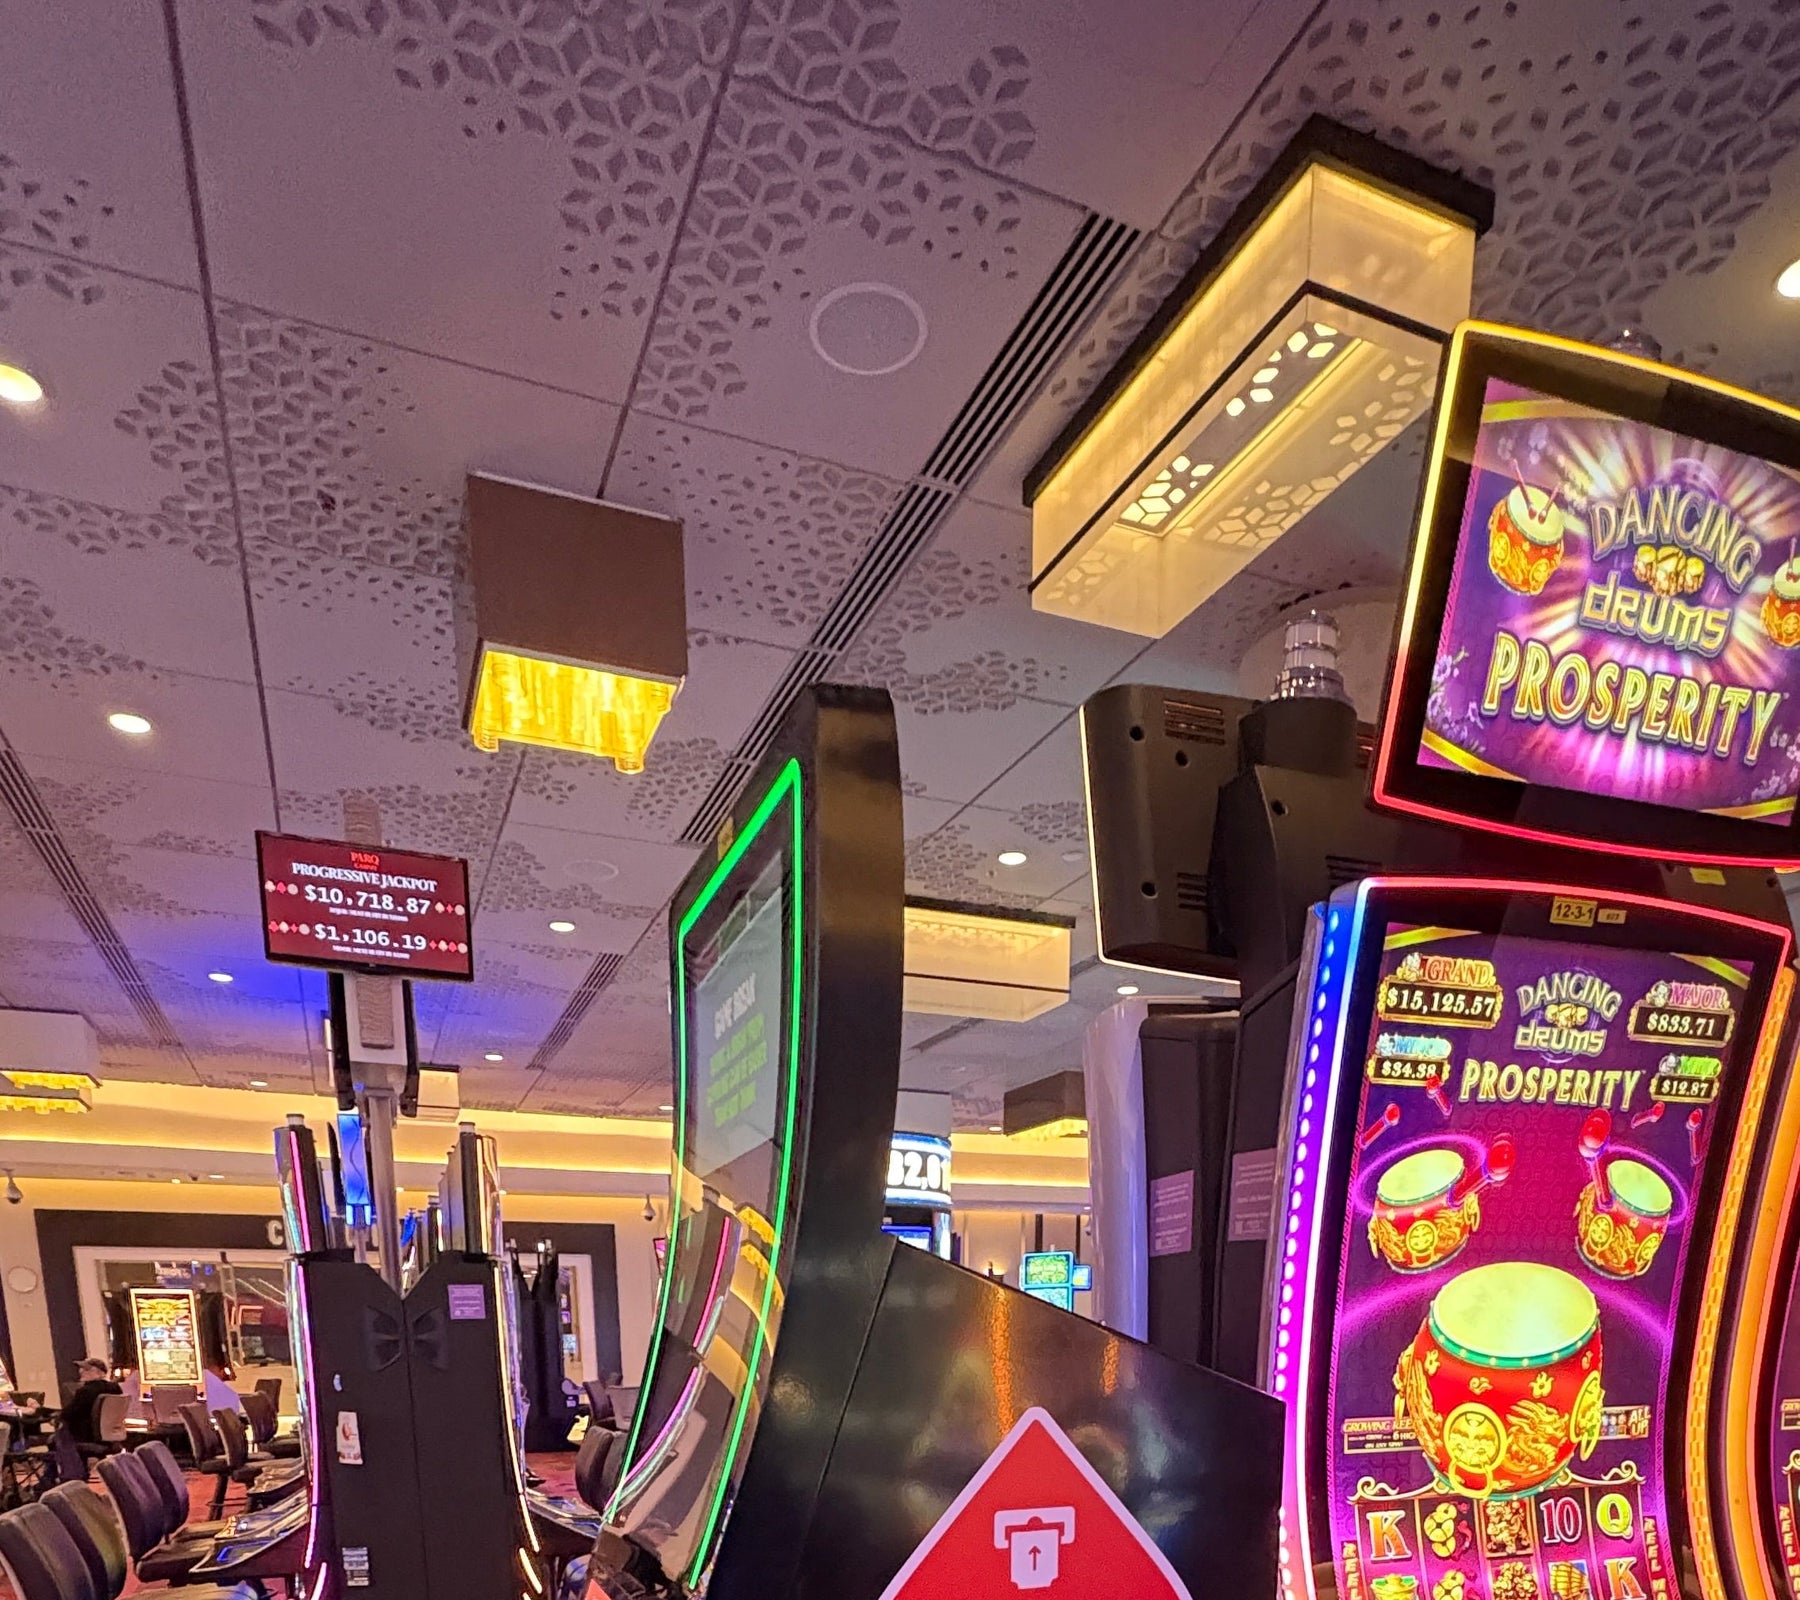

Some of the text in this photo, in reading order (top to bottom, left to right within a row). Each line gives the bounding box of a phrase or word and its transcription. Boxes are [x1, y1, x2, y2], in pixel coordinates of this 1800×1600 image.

[1592, 486, 1761, 592] DANCING
[1482, 631, 1781, 765] PROSPERITY
[350, 852, 379, 866] PARQ
[292, 862, 437, 892] PROGRESSIVE JACKPOT
[304, 884, 430, 915] $10,718.87
[314, 923, 427, 951] $1,106.19
[1426, 959, 1491, 987] GRAND
[1386, 987, 1496, 1018] $15,125.57
[1517, 971, 1622, 1022] DANCING
[1647, 1012, 1715, 1037] $833.71
[1459, 1058, 1641, 1112] PROSPERITY
[1631, 1420, 1649, 1436] UP
[1540, 1497, 1582, 1544] 10
[1596, 1493, 1633, 1540] Q
[1366, 1510, 1412, 1561] K
